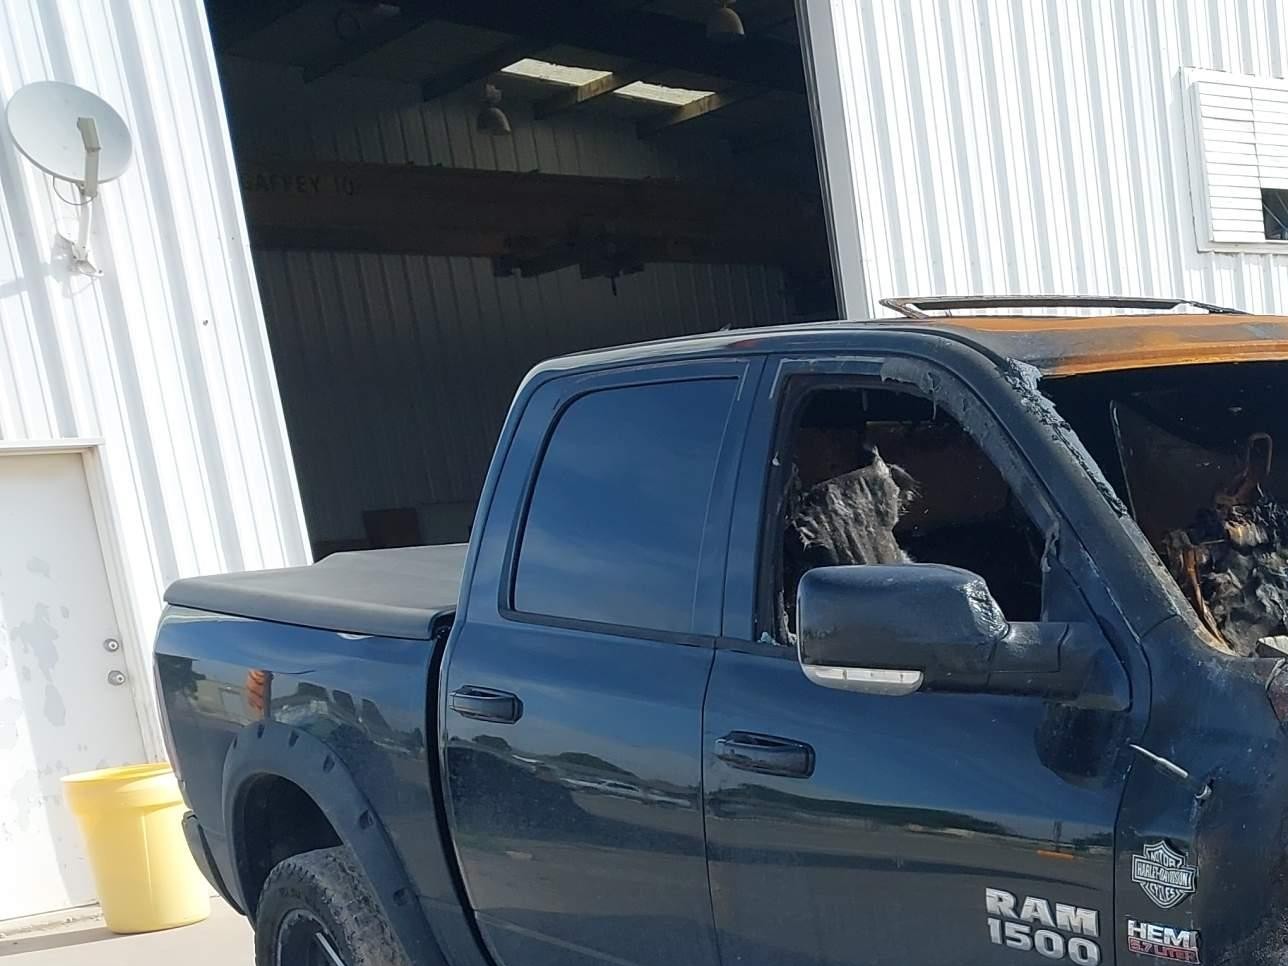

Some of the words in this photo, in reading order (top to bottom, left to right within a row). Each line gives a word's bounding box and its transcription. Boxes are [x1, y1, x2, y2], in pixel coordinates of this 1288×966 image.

[1150, 849, 1176, 868] MOTOR
[1136, 862, 1189, 887] HARLEY-DAVIDSON
[1149, 882, 1177, 902] CYCLES
[985, 887, 1099, 938] RAM
[1127, 919, 1199, 949] HEMI
[1153, 943, 1197, 962] LITER
